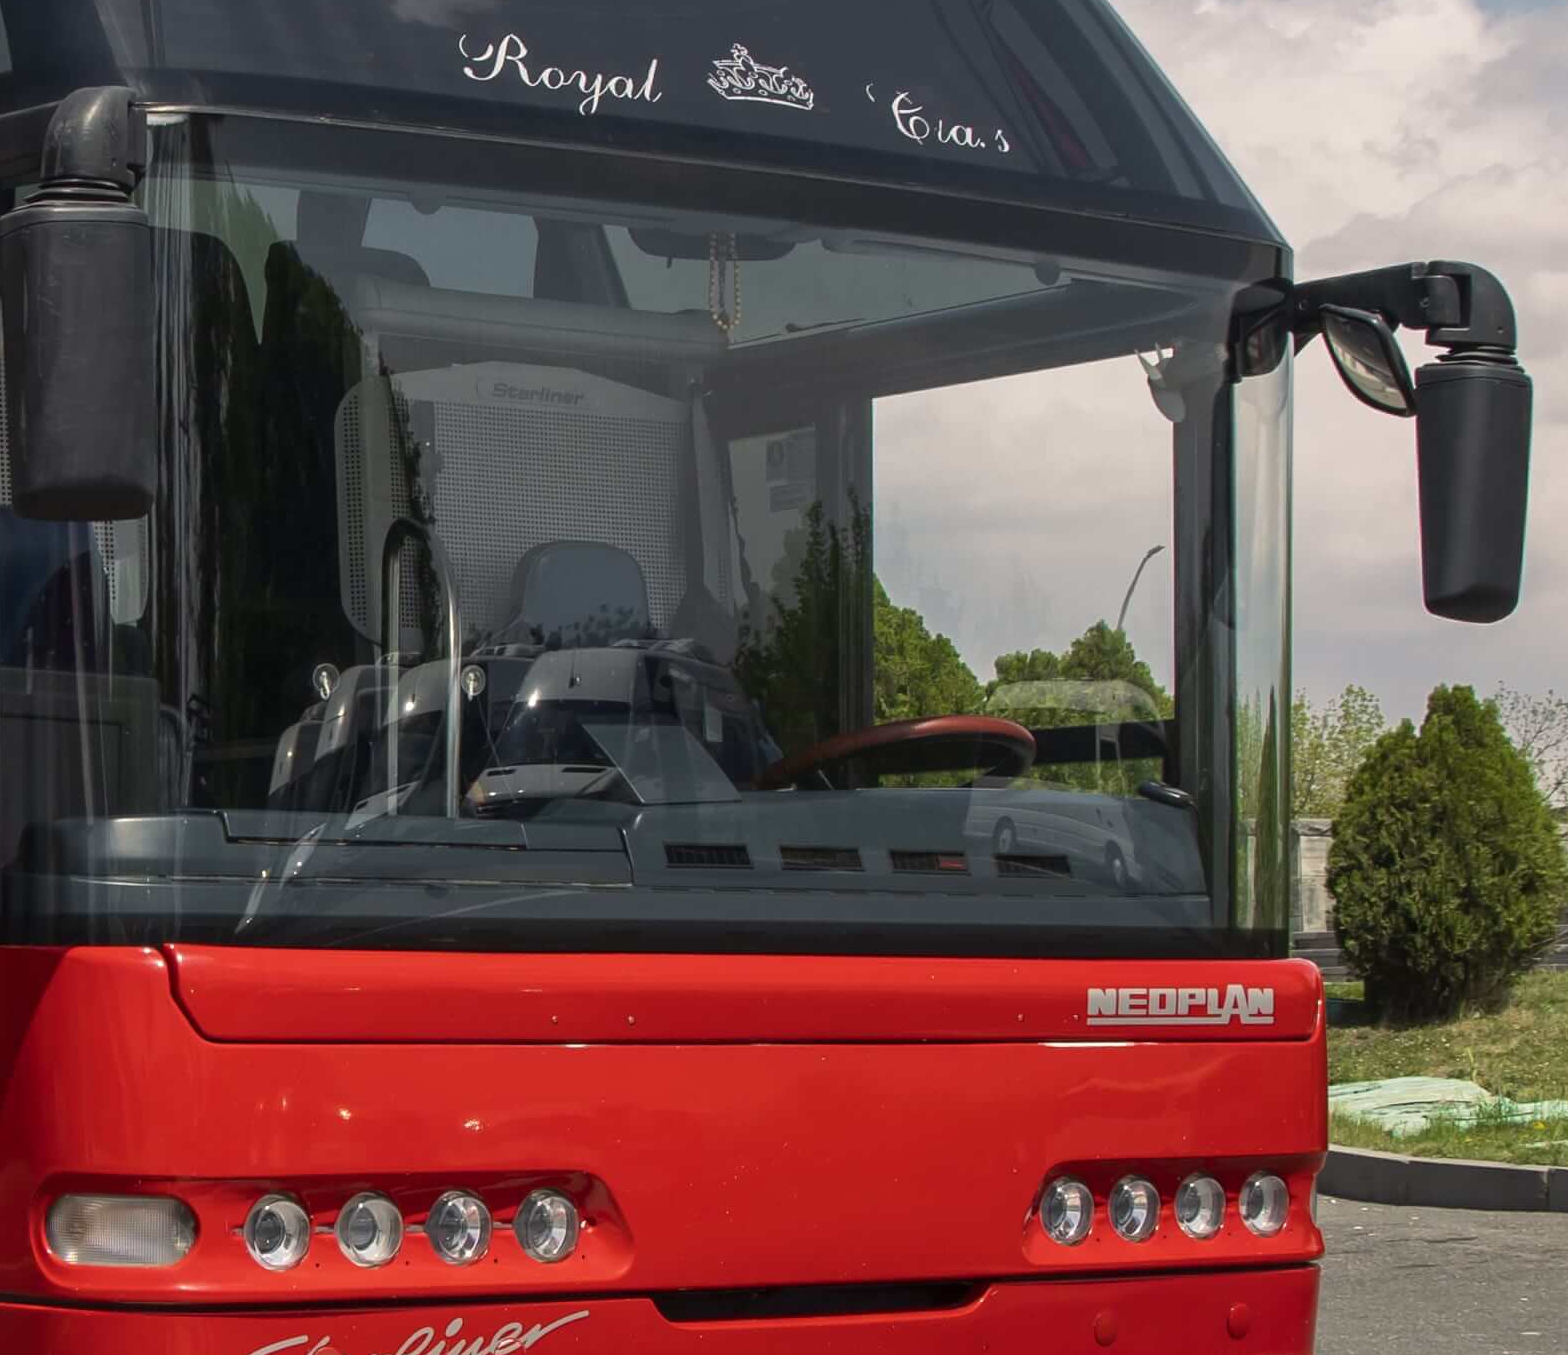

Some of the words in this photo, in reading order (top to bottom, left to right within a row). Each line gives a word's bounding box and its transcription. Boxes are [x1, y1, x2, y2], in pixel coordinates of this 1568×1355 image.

[459, 34, 662, 115] Royal
[492, 382, 584, 406] Starliner
[1087, 984, 1274, 1025] NEOPLAN
